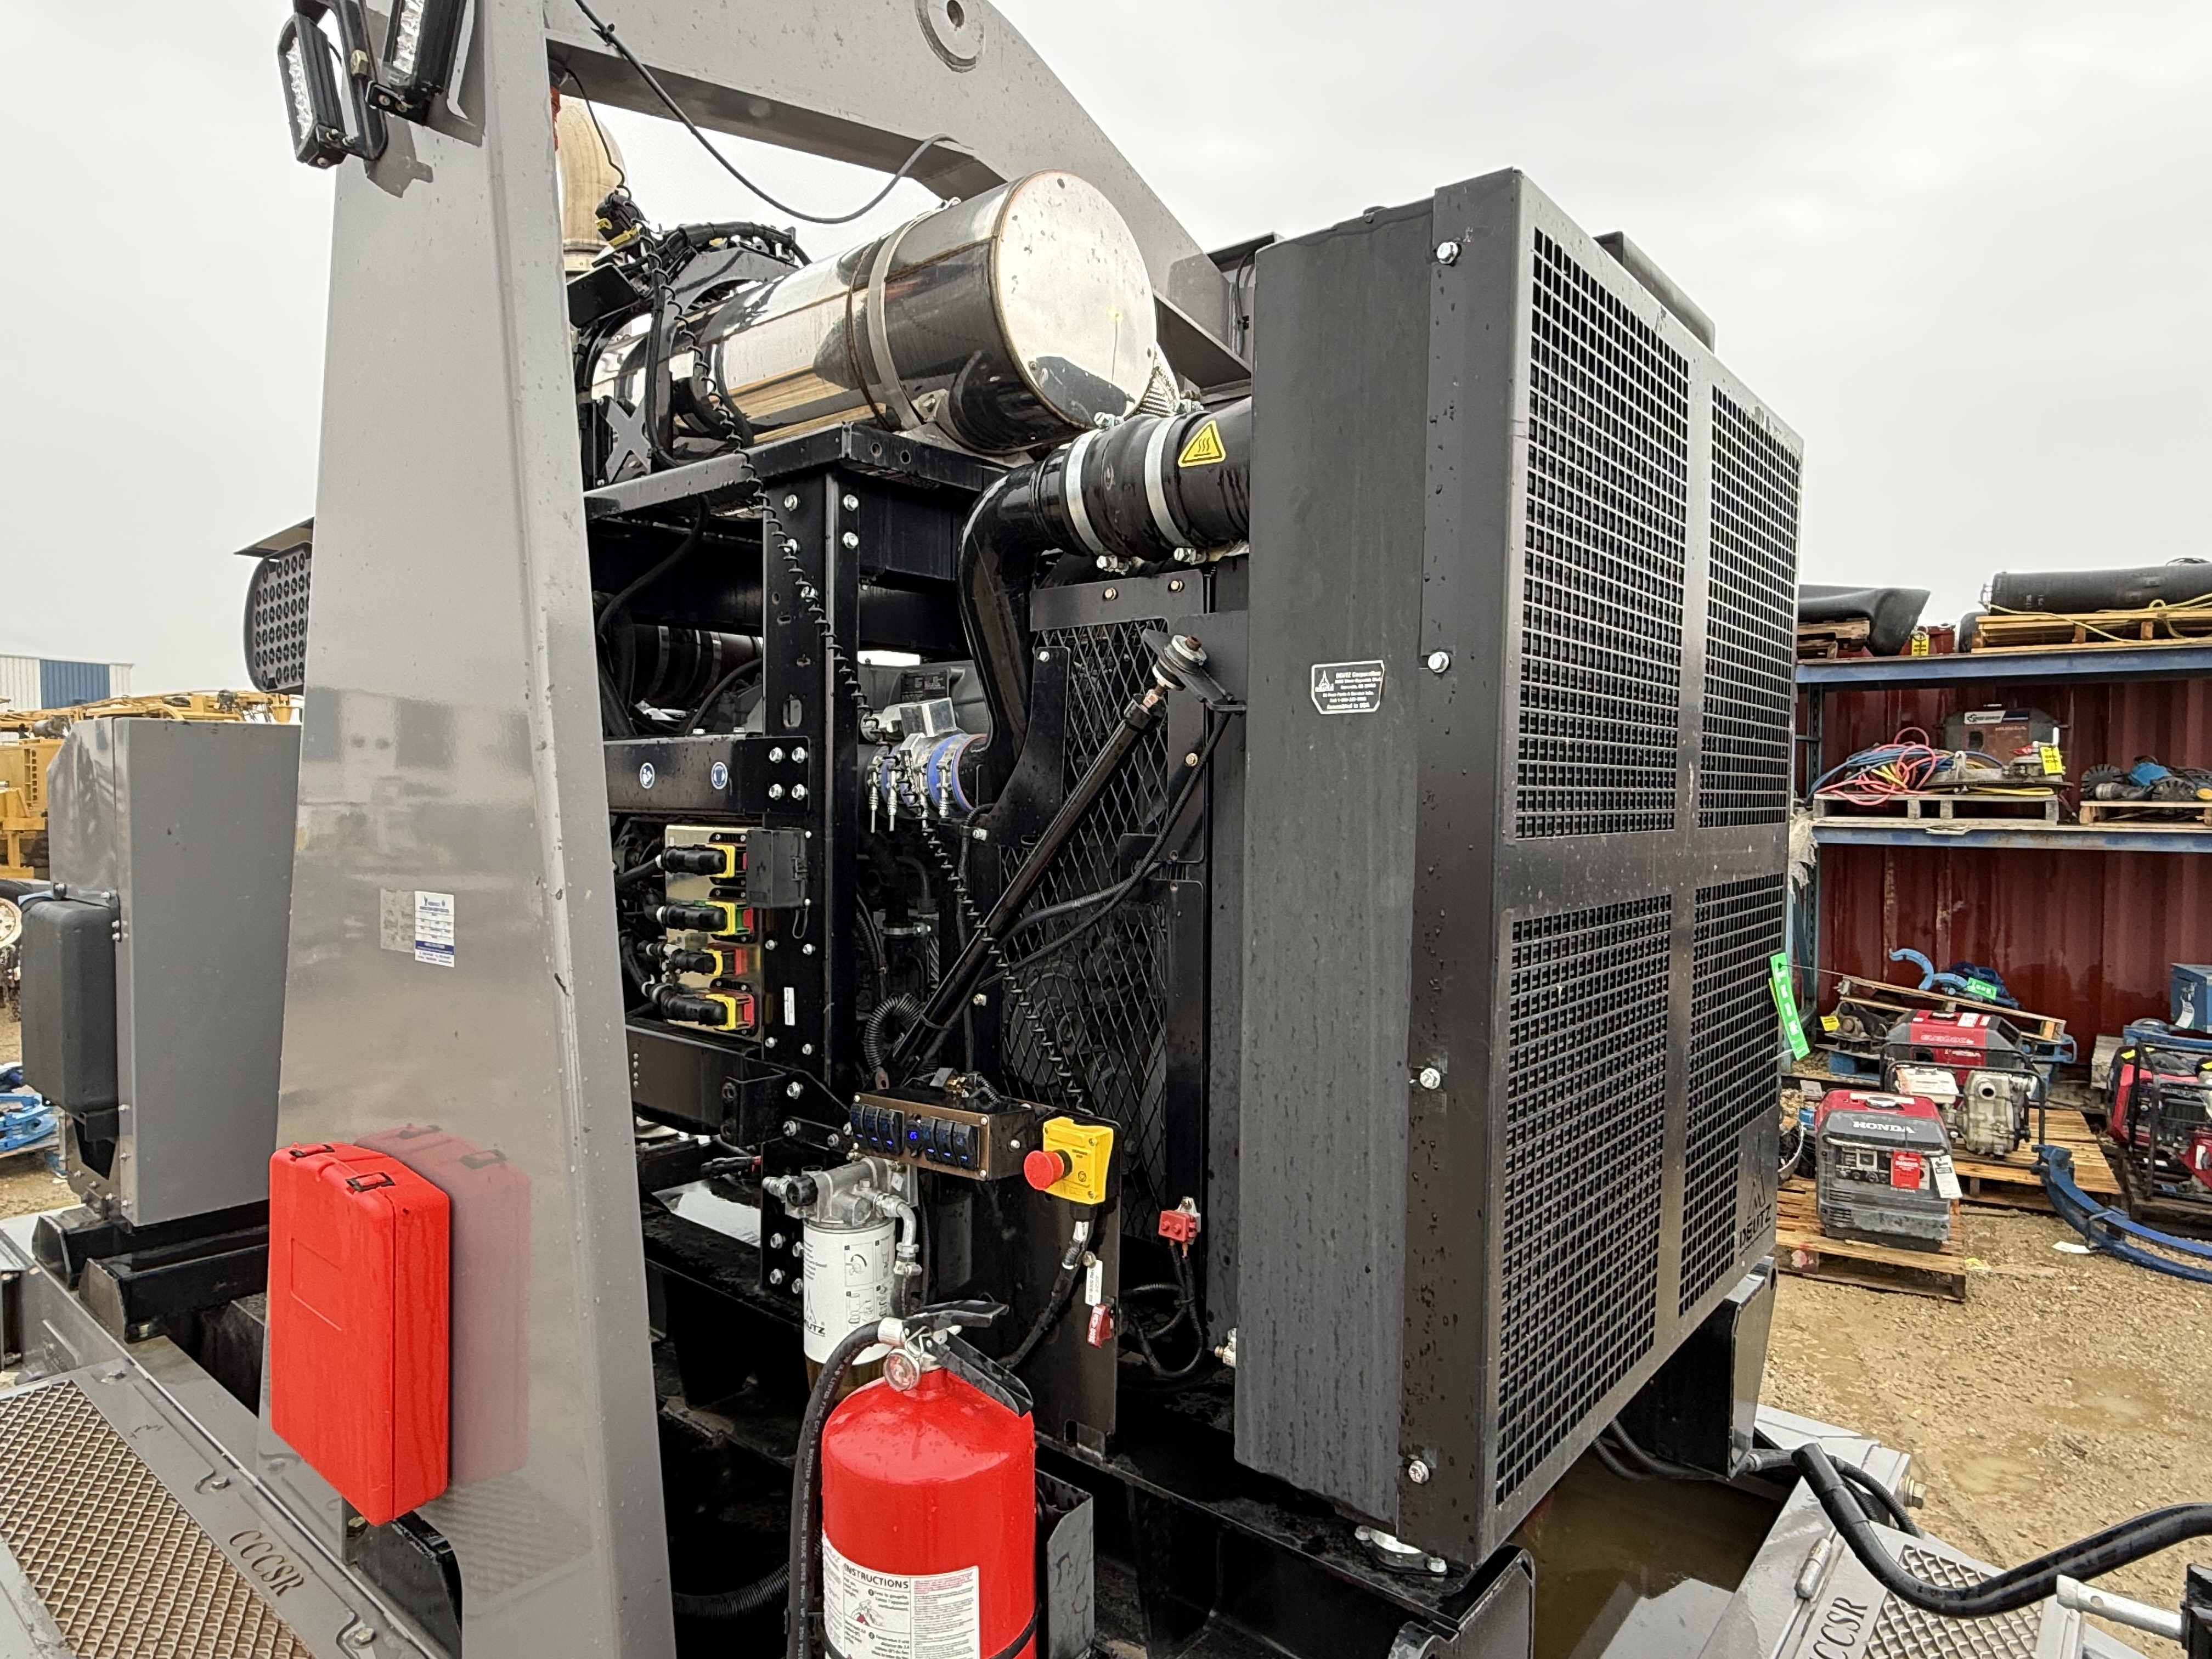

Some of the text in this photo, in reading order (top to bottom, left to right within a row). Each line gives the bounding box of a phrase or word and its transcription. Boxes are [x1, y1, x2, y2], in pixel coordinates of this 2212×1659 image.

[1853, 1121, 1916, 1133] HONDA
[1739, 1203, 1771, 1249] DEUTZ
[229, 1529, 304, 1597] CCCSR
[844, 1564, 909, 1589] INSTRUCTIONS
[1808, 1596, 1869, 1659] CCSR
